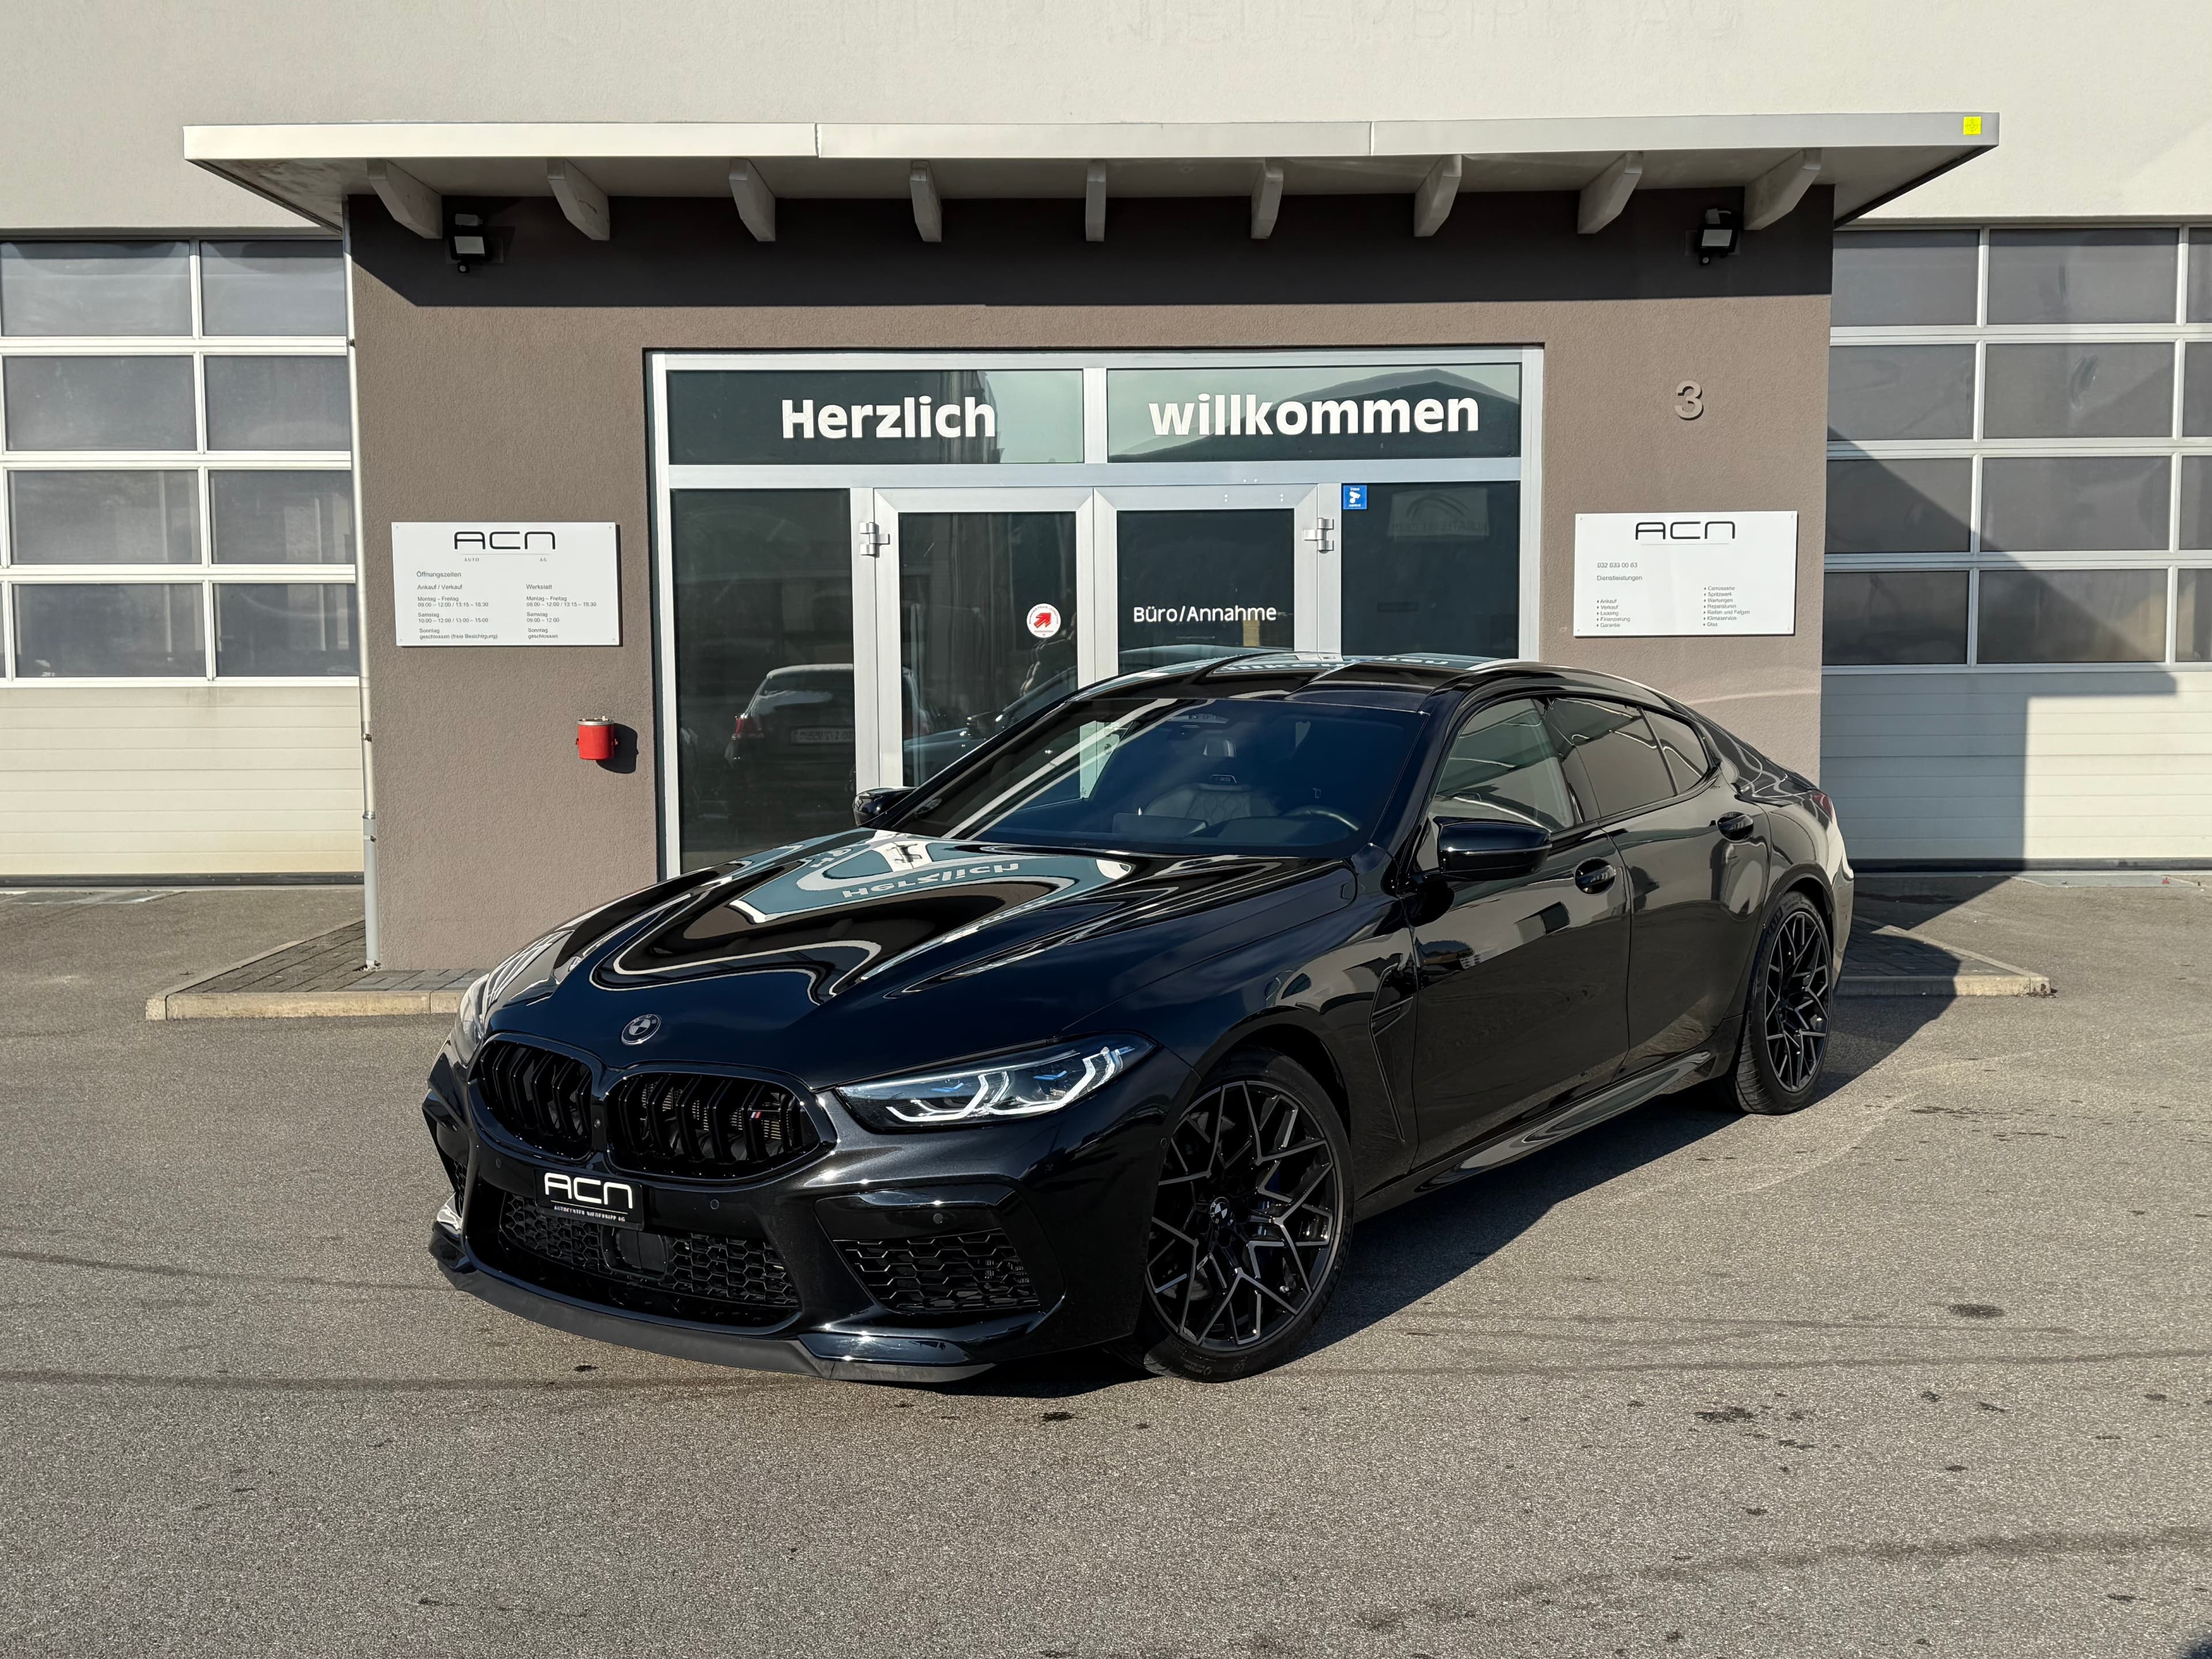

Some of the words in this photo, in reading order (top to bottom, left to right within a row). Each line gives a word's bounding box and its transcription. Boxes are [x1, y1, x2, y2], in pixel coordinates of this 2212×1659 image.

[782, 396, 995, 438] Herzlich
[1149, 393, 1479, 436] willkommen
[1675, 380, 1704, 421] 3
[1134, 605, 1277, 622] Büro/Annahme
